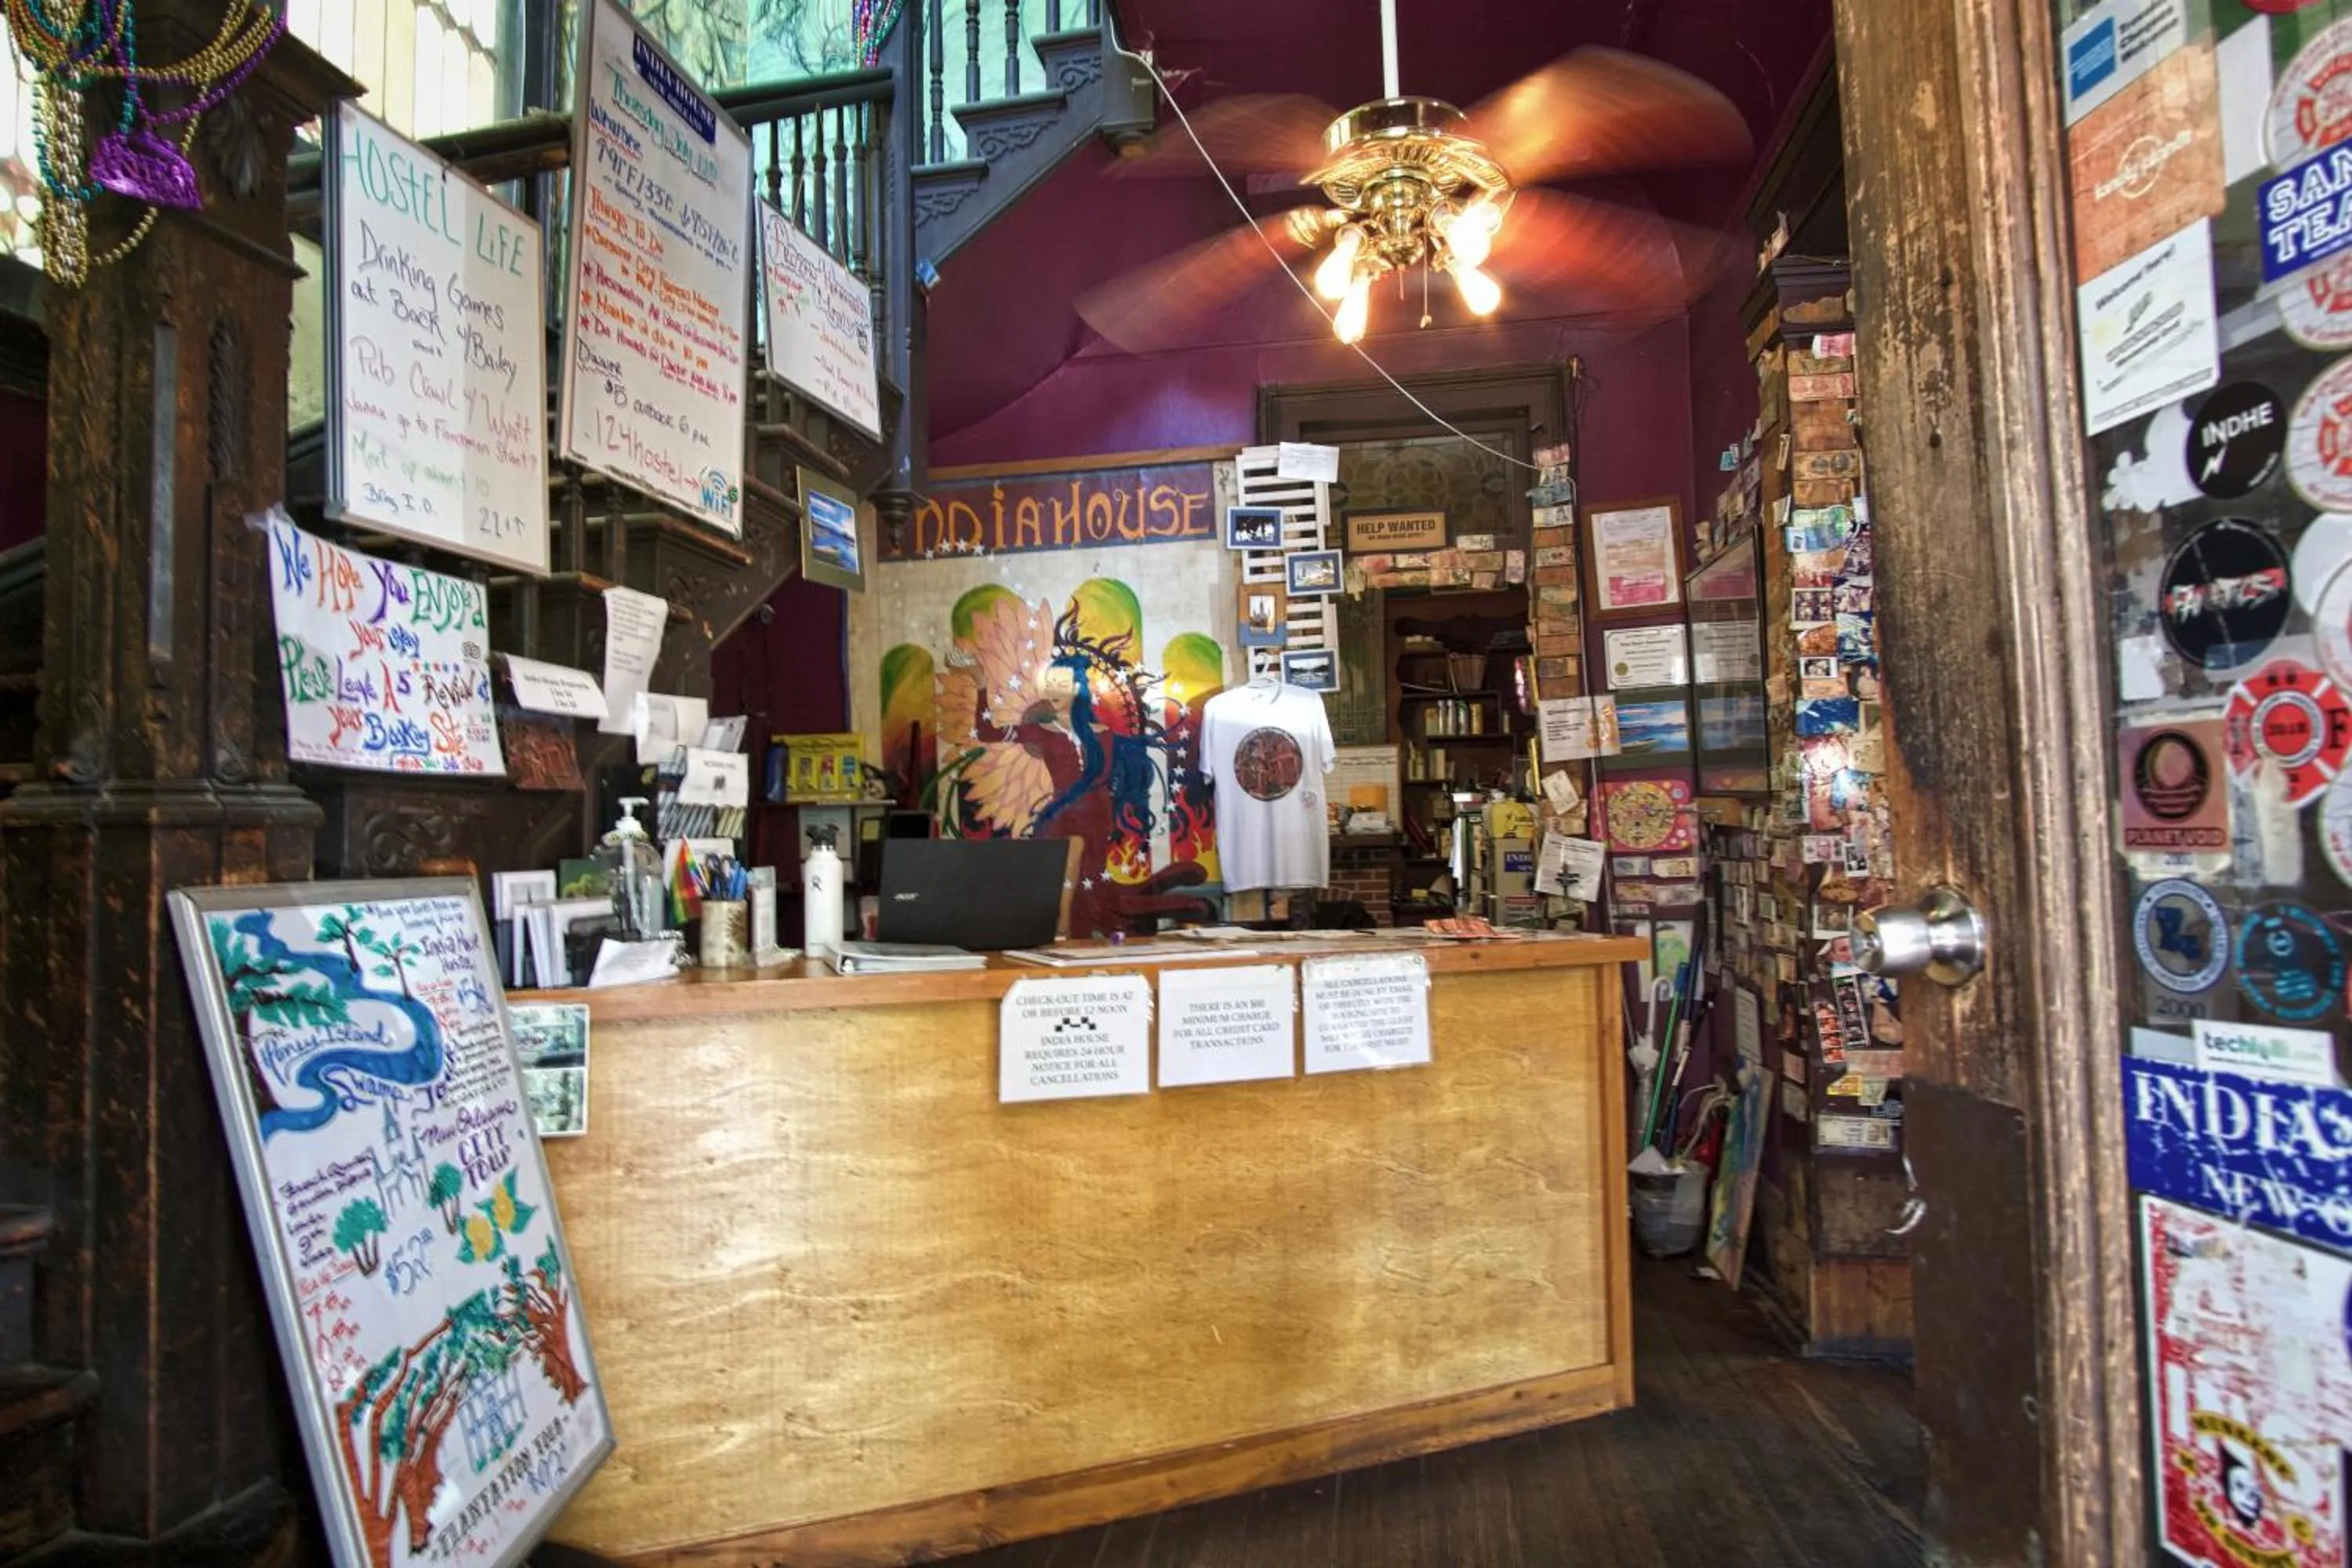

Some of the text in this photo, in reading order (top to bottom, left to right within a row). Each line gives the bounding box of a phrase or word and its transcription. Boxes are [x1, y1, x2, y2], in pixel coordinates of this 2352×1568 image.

[349, 335, 395, 387] Pub
[701, 485, 734, 519] WiFi
[894, 481, 1210, 556] NDIA HOUSE
[1356, 518, 1436, 535] HELP WANTED
[274, 523, 311, 598] We
[368, 560, 412, 625] You
[398, 669, 412, 695] 5
[2125, 828, 2181, 847] PLANET
[1082, 992, 1107, 1003] TIME
[1109, 992, 1119, 1001] IS
[1121, 991, 1134, 1000] AT
[1022, 1008, 1038, 1019] OR
[1040, 1006, 1081, 1018] BEFORE
[1083, 1005, 1096, 1015] 12
[1214, 1024, 1252, 1035] CREDIT
[1253, 1021, 1281, 1033] CARD
[1040, 1033, 1110, 1047] INDIA HOUSE
[1024, 1047, 1079, 1061] REQUIRES
[1032, 1057, 1118, 1073] NOTICE FOR ALL
[1029, 1070, 1120, 1086] CANCELLATIONS
[458, 1122, 505, 1167] CITY
